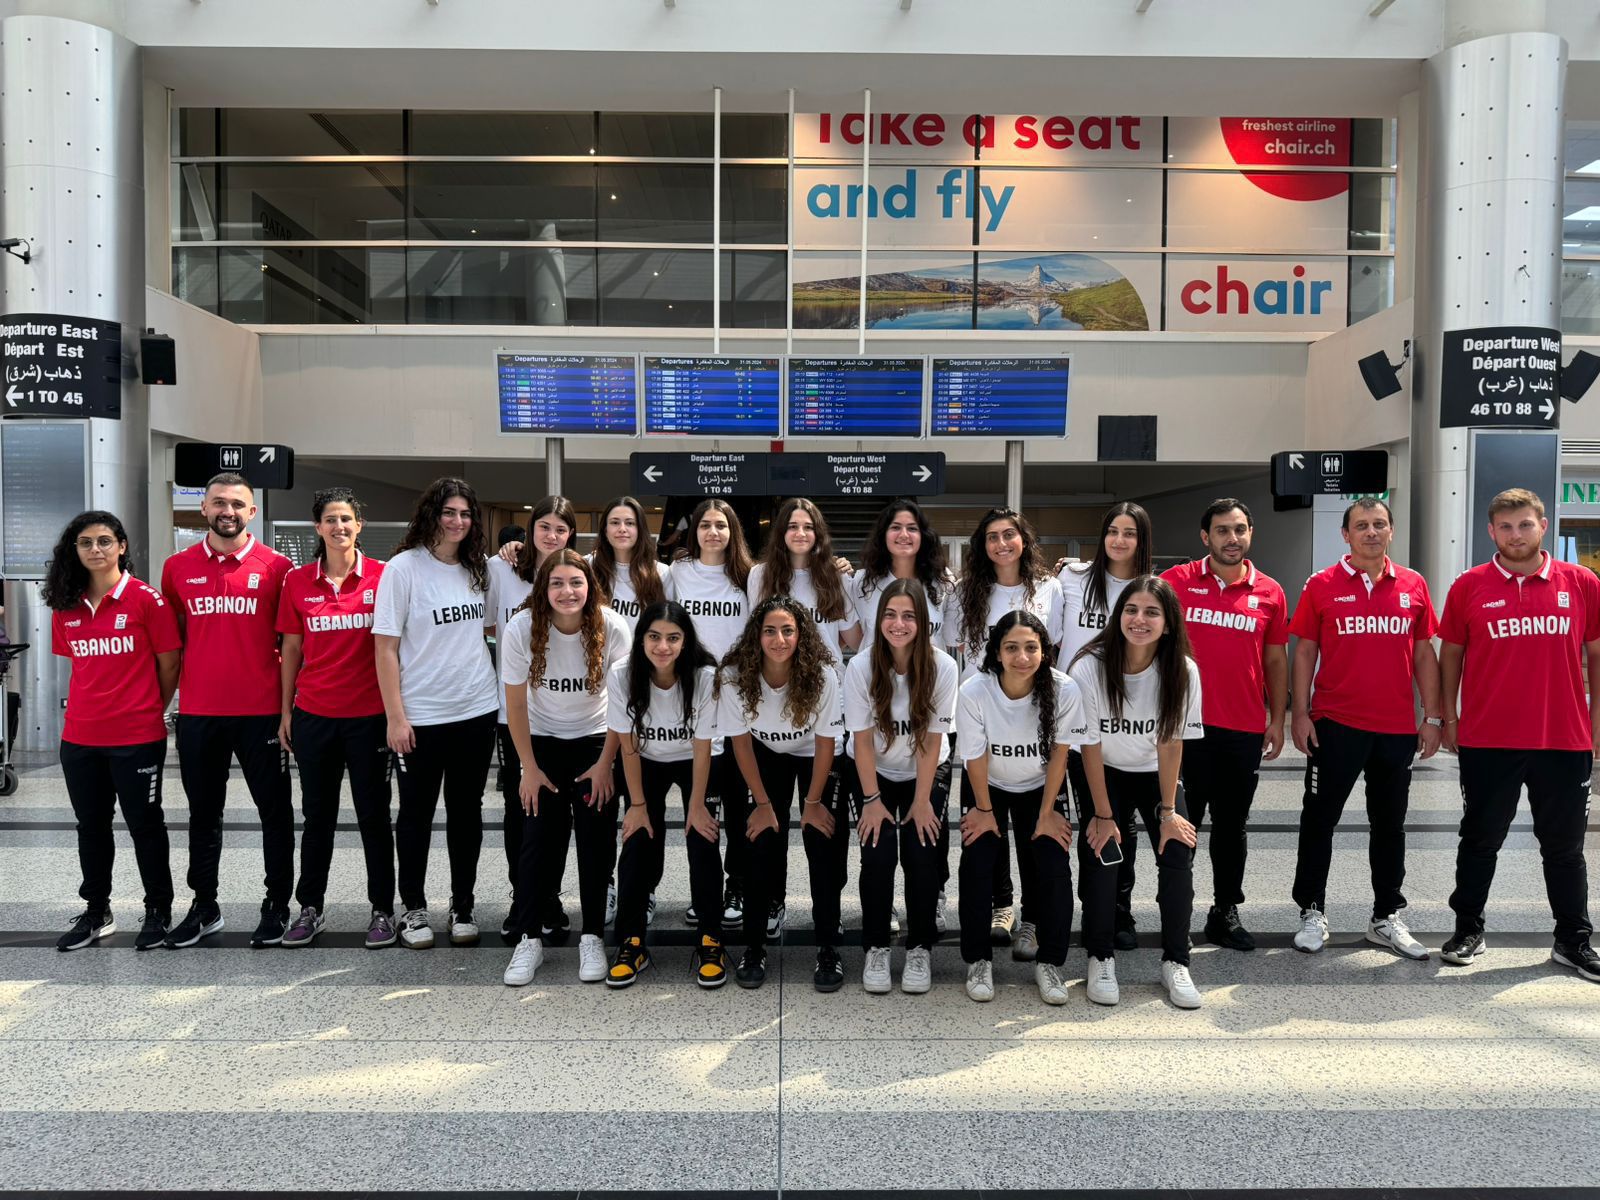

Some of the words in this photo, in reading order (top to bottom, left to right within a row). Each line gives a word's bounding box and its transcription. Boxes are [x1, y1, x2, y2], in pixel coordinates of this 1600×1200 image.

[1014, 115, 1141, 150] seat
[1242, 119, 1294, 132] freshest
[1296, 120, 1336, 132] airline
[1264, 138, 1336, 155] chair.ch
[807, 169, 916, 219] and
[936, 169, 1016, 232] fly
[1181, 265, 1332, 314] chair
[62, 324, 98, 340] East
[4, 342, 44, 358] Départ
[57, 344, 84, 358] Est
[1463, 336, 1538, 352] Departure
[1540, 337, 1560, 354] West
[1472, 356, 1526, 372] Départ
[1528, 356, 1556, 371] Ouest
[44, 365, 82, 381] ذهاب
[1529, 376, 1554, 392] ذهاب
[28, 390, 34, 403] 1
[38, 390, 58, 404] TO
[62, 392, 84, 405] 45
[1470, 403, 1490, 416] 46
[1493, 402, 1512, 415] TO
[1515, 402, 1532, 415] 88
[691, 454, 727, 463] Departure
[728, 454, 744, 462] East
[828, 455, 866, 464] Departure
[699, 464, 724, 473] Départ
[834, 465, 858, 474] Départ
[188, 596, 257, 615] LEBANON
[432, 602, 486, 625] LEBANO
[680, 600, 740, 617] EBANON
[307, 612, 374, 632] LEBANON
[1186, 607, 1257, 632] LEBANON
[1336, 616, 1411, 635] LEBANON
[1487, 616, 1570, 639] LEBANON
[69, 635, 134, 657] EBANON
[1100, 718, 1156, 734] EBANO
